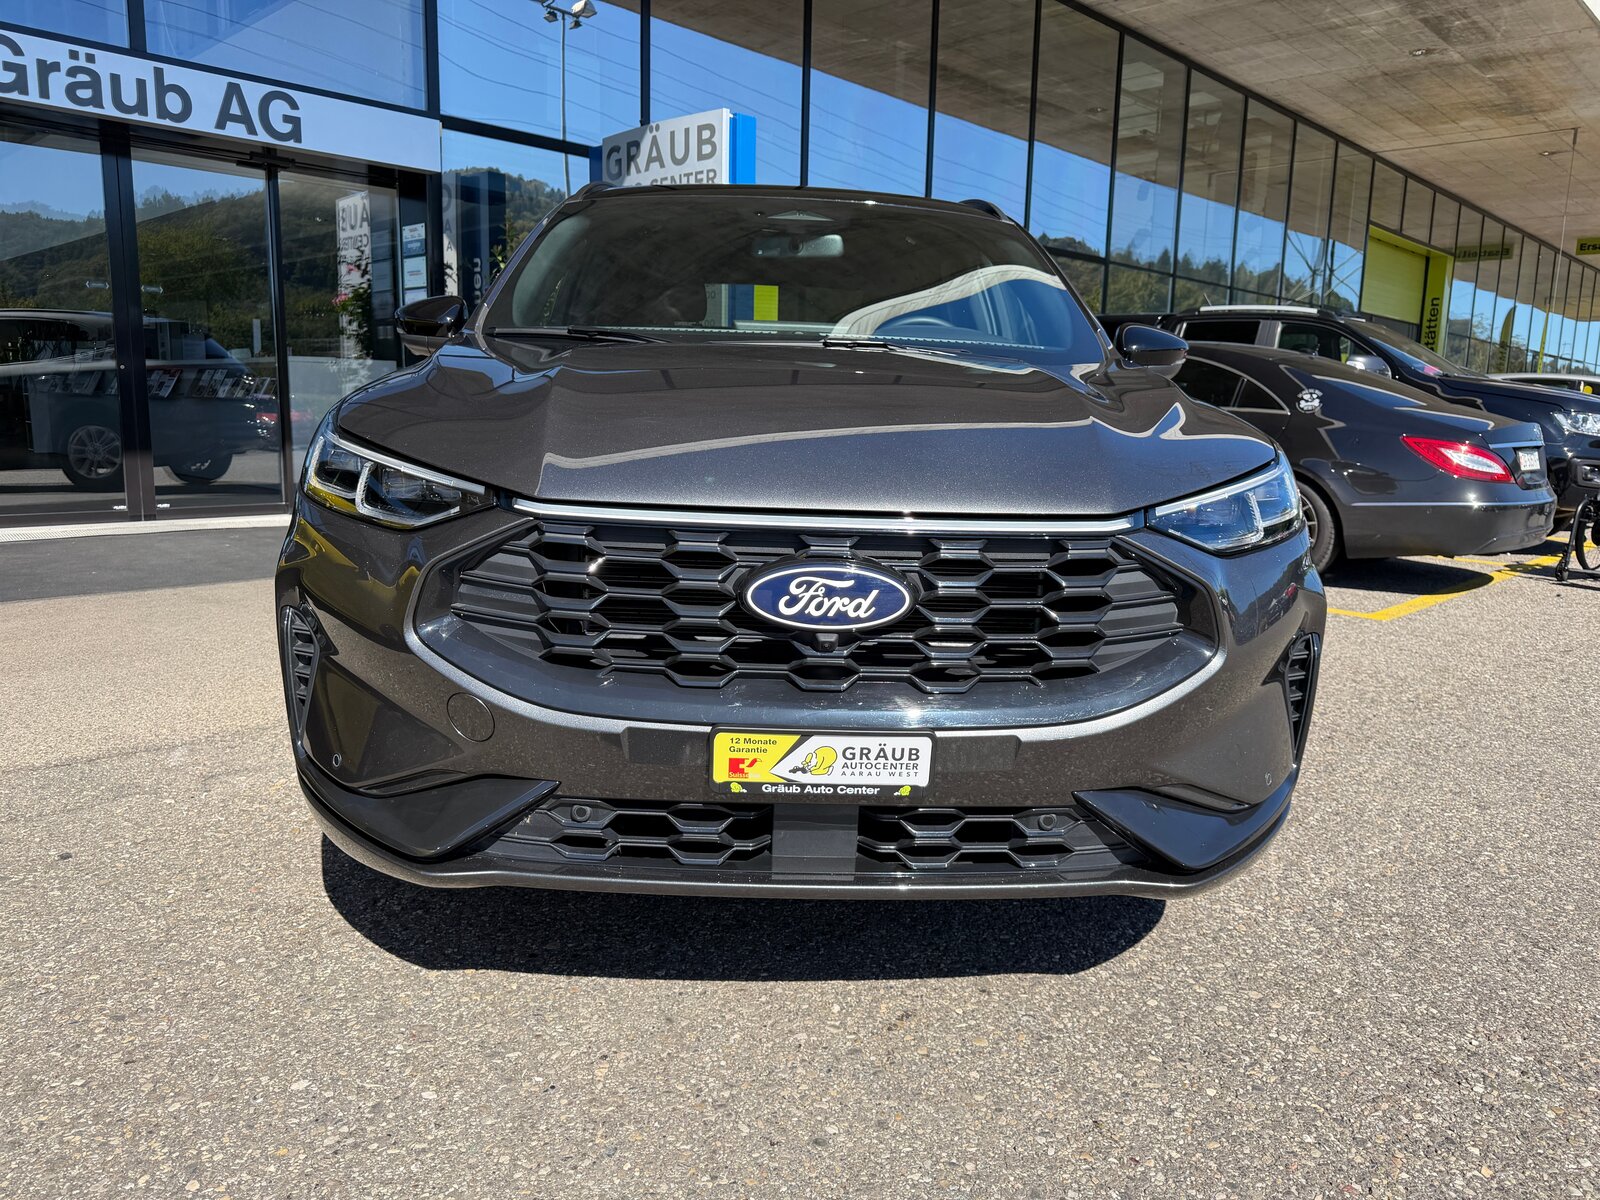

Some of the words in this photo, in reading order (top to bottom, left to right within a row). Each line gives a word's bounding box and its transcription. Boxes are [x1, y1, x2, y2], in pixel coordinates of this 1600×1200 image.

[0, 33, 193, 124] Gräub
[214, 81, 303, 144] AG
[606, 123, 717, 181] GRÄUB
[778, 577, 879, 618] Ford
[744, 738, 777, 746] Monate
[842, 743, 920, 761] GRÄUB
[842, 762, 919, 770] AUTOCENTER
[762, 784, 801, 793] Gräub
[804, 785, 833, 794] Auto
[837, 785, 880, 795] Center
